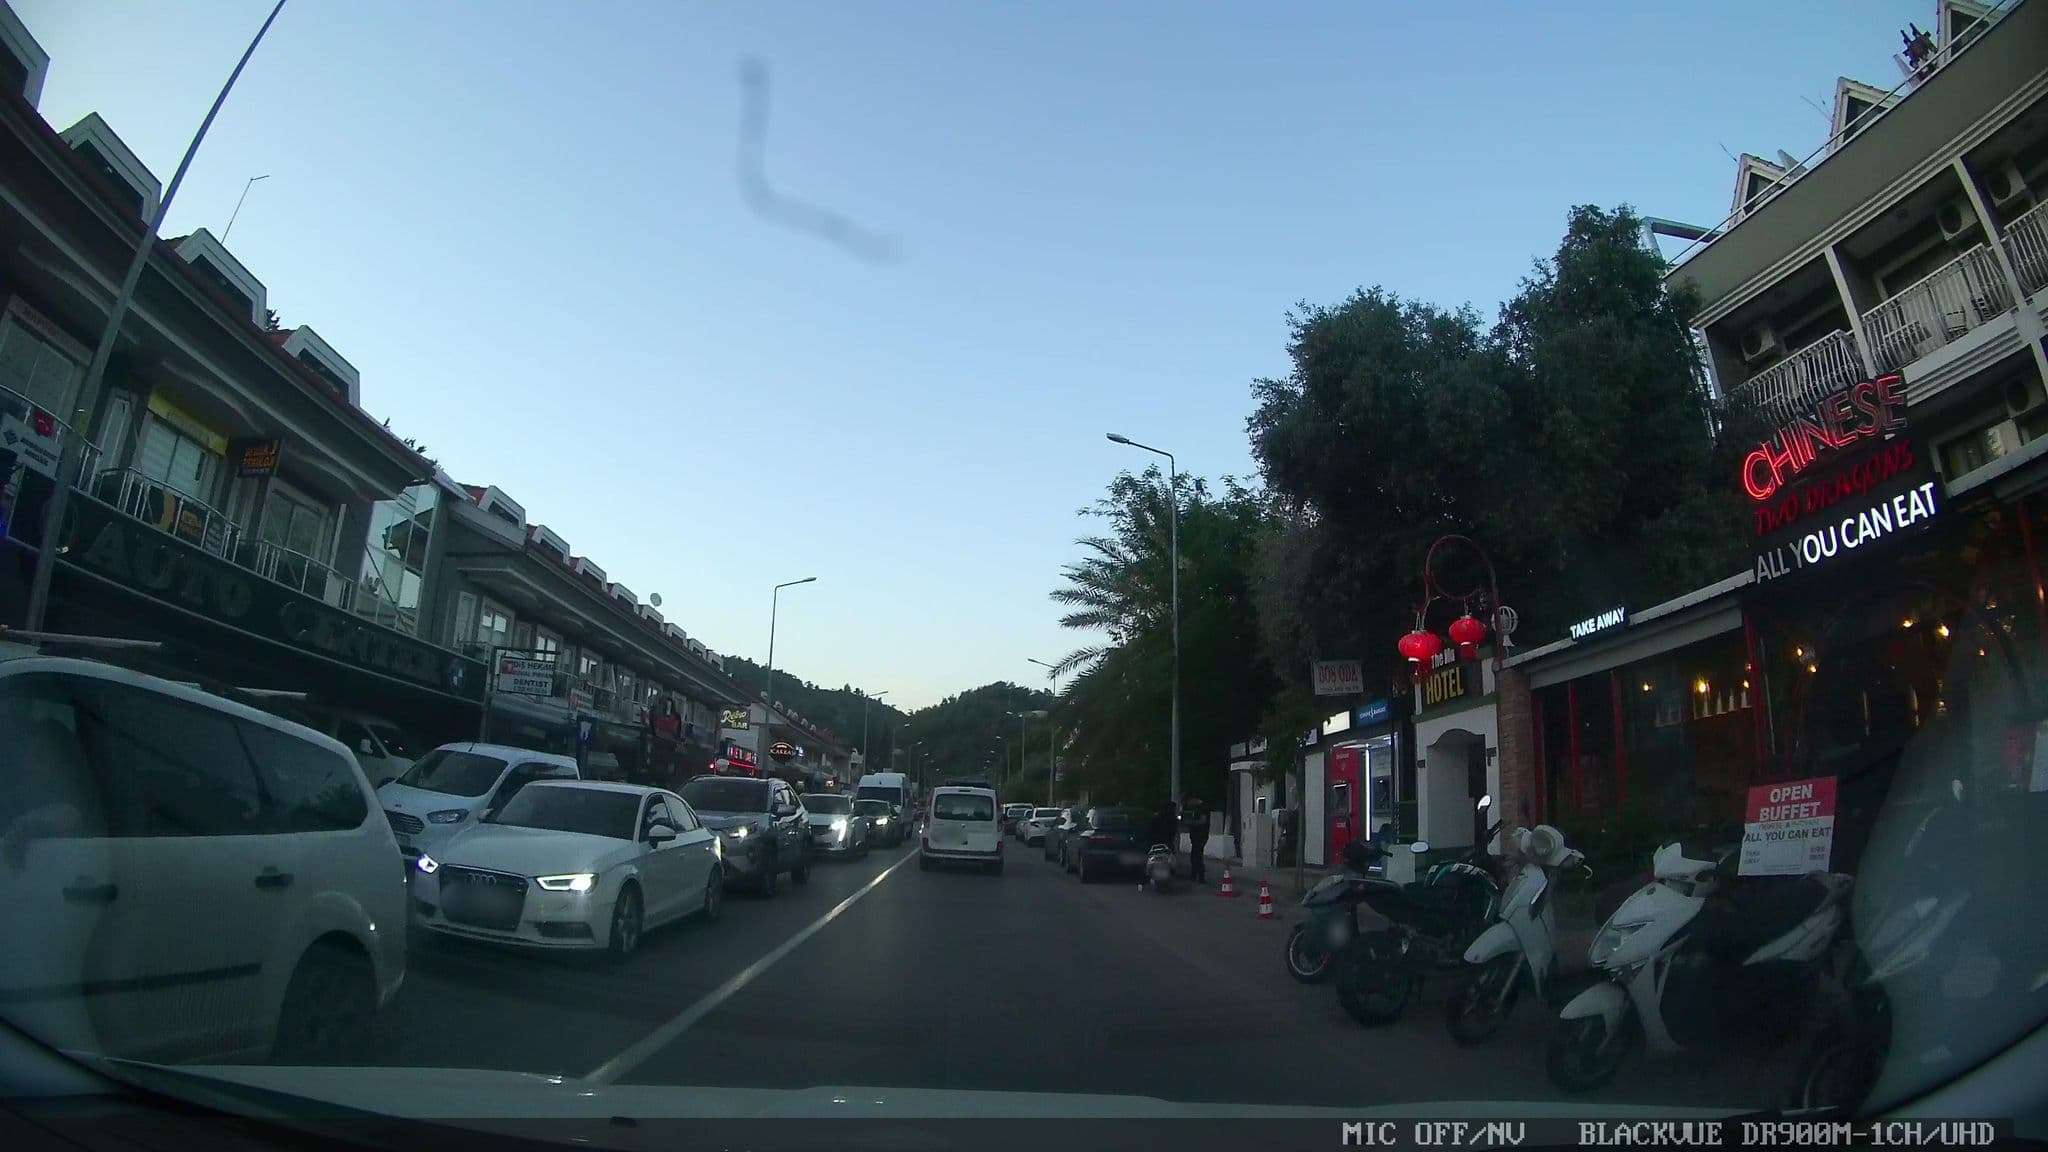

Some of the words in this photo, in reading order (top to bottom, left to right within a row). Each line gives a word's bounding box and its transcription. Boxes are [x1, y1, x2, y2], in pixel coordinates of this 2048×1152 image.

[1743, 375, 1907, 500] CHINESE
[1754, 492, 1801, 536] TWO
[1805, 440, 1914, 513] DRAGONS
[1756, 547, 1790, 584] ALL
[1789, 525, 1838, 569] YOU
[1841, 502, 1893, 548] CAN
[1893, 481, 1936, 528] EAT
[1569, 617, 1596, 639] TAKE
[1596, 606, 1625, 631] AWAY
[513, 678, 549, 689] DENTIST
[1426, 666, 1464, 705] HOTEL
[731, 721, 748, 730] BAR
[1770, 783, 1813, 803] OPEN
[1760, 801, 1821, 822] BUFFET
[1744, 832, 1762, 843] ALL
[1766, 829, 1785, 841] YOU
[1787, 827, 1809, 840] CAN
[1811, 826, 1832, 838] EAT
